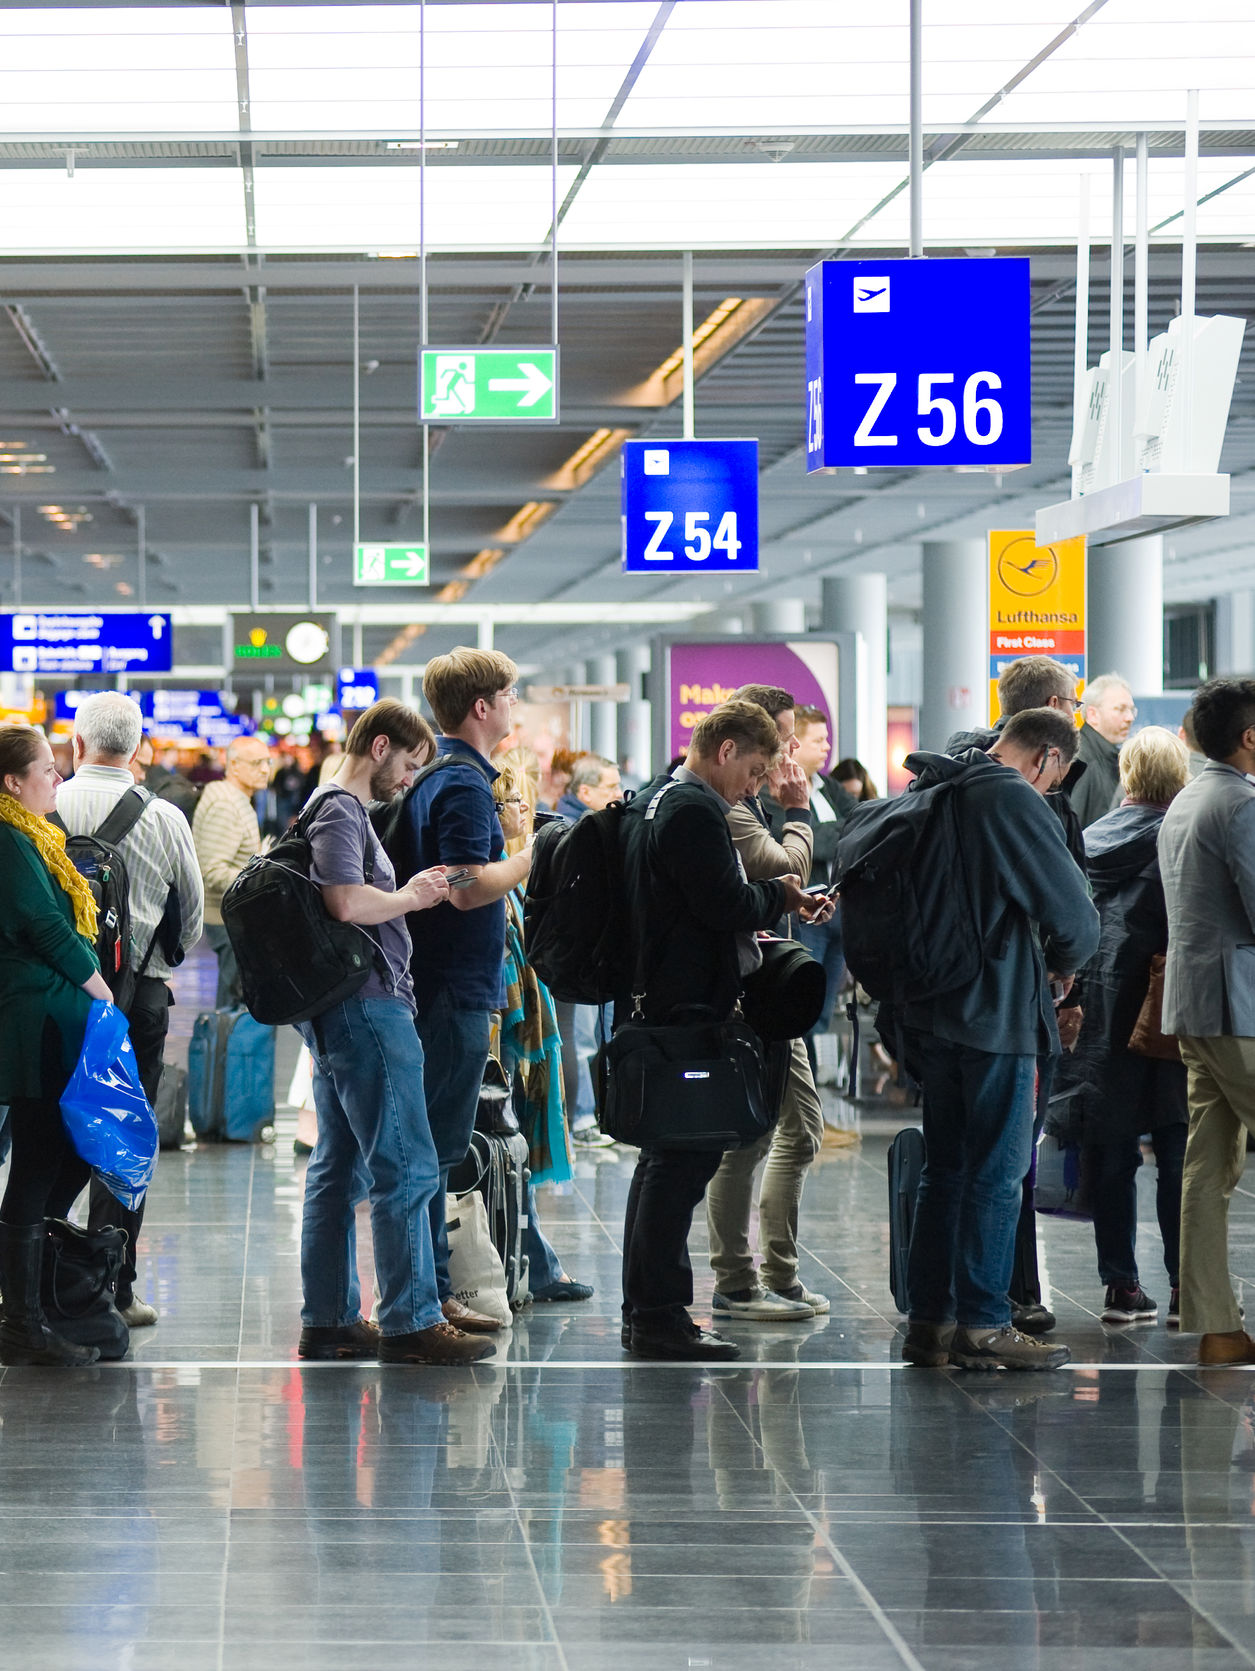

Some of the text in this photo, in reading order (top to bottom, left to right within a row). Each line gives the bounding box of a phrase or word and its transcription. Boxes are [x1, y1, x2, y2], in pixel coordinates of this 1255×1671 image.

[808, 381, 814, 453] Z
[854, 371, 1004, 446] Z 56
[644, 511, 674, 560] Z
[684, 511, 742, 560] 54
[998, 611, 1078, 623] Lufthansa
[997, 637, 1055, 648] First Class
[455, 1290, 479, 1300] etter
